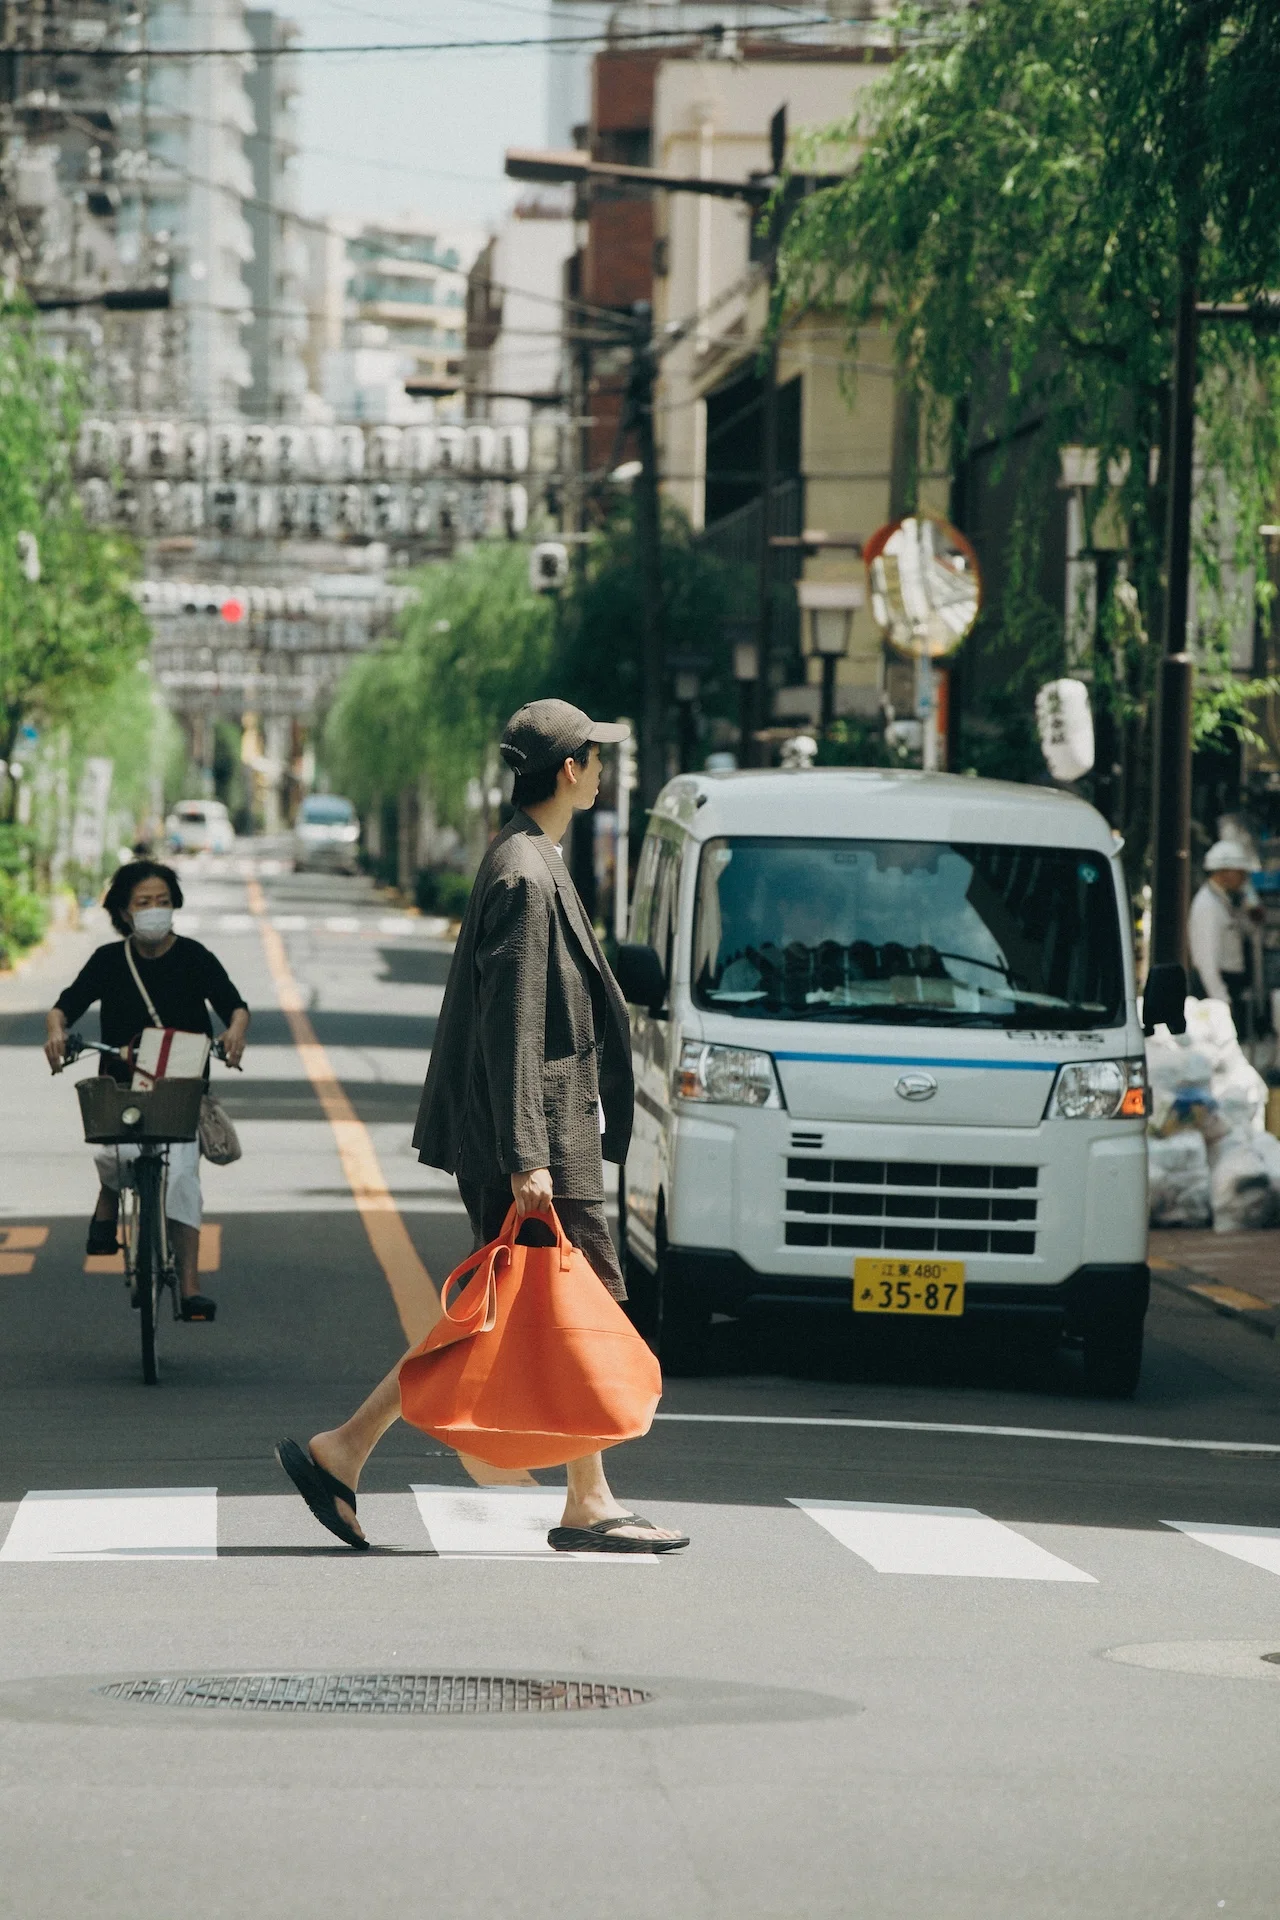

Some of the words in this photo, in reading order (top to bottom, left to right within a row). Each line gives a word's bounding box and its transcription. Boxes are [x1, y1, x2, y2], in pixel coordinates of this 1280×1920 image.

[881, 1263, 911, 1277] 江東
[914, 1263, 941, 1279] 480
[878, 1281, 958, 1311] 35-87
